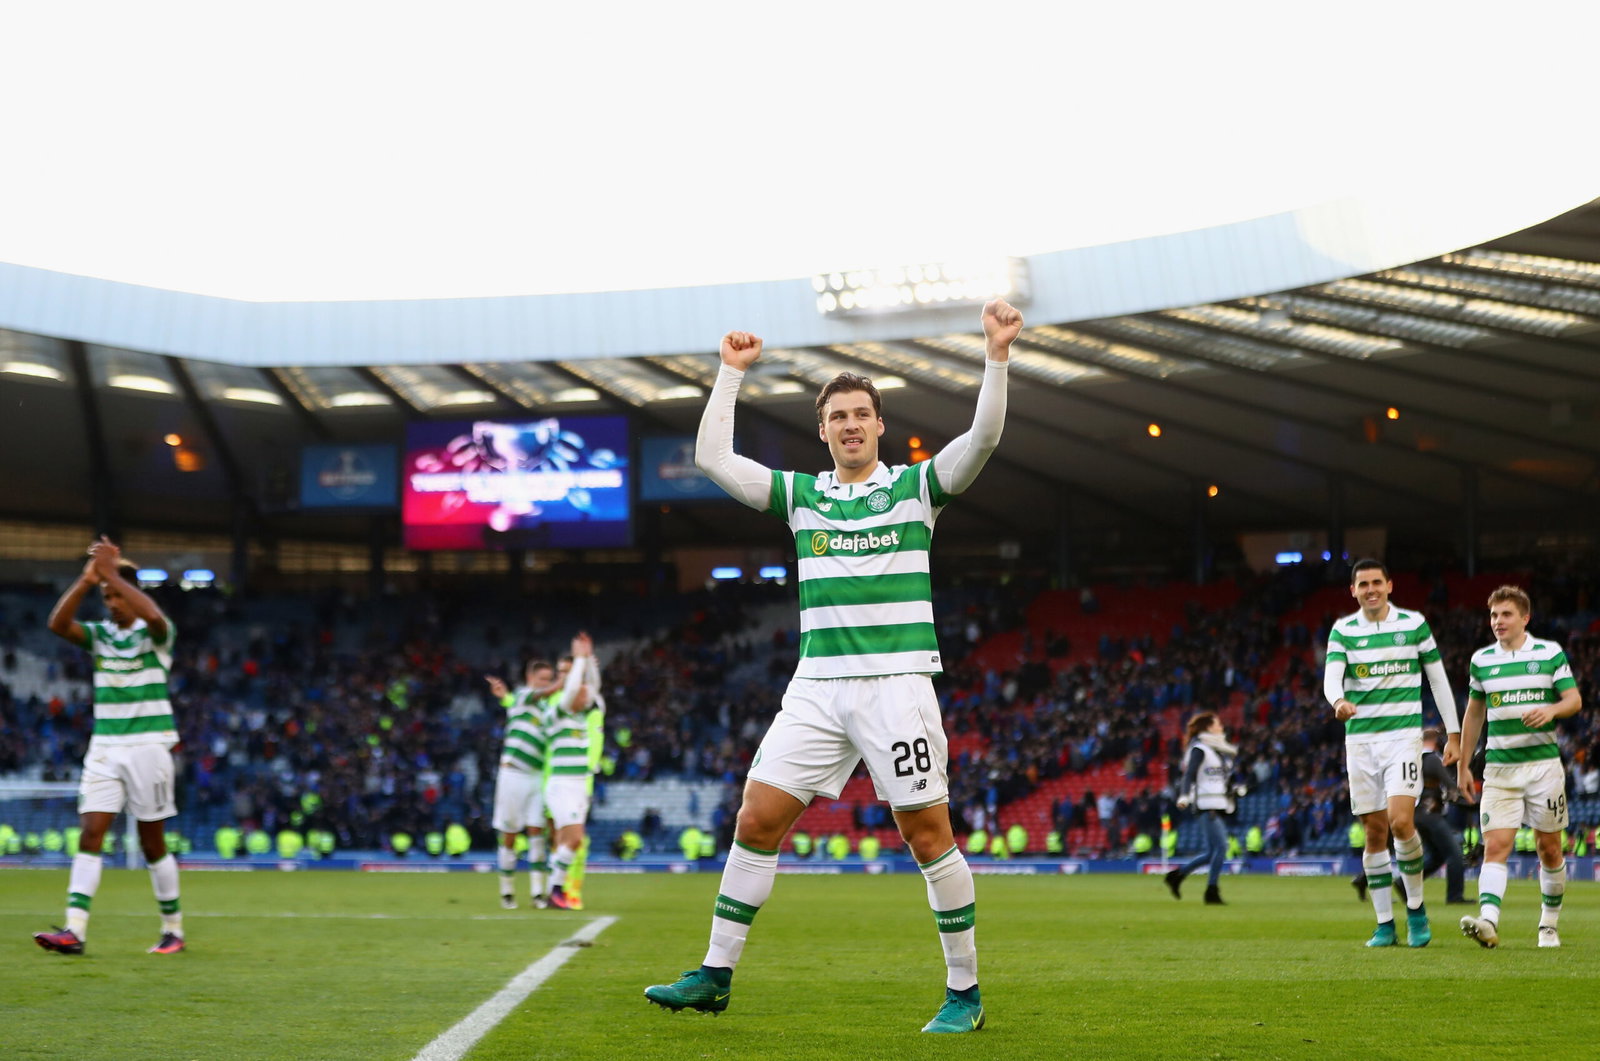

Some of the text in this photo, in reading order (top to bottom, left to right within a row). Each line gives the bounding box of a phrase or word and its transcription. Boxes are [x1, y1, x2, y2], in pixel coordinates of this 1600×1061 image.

[829, 530, 899, 553] dafabet
[1369, 661, 1410, 675] dafabet
[1502, 690, 1545, 703] dafabet
[891, 737, 931, 777] 28
[1402, 761, 1418, 781] 18
[1547, 794, 1565, 818] 49
